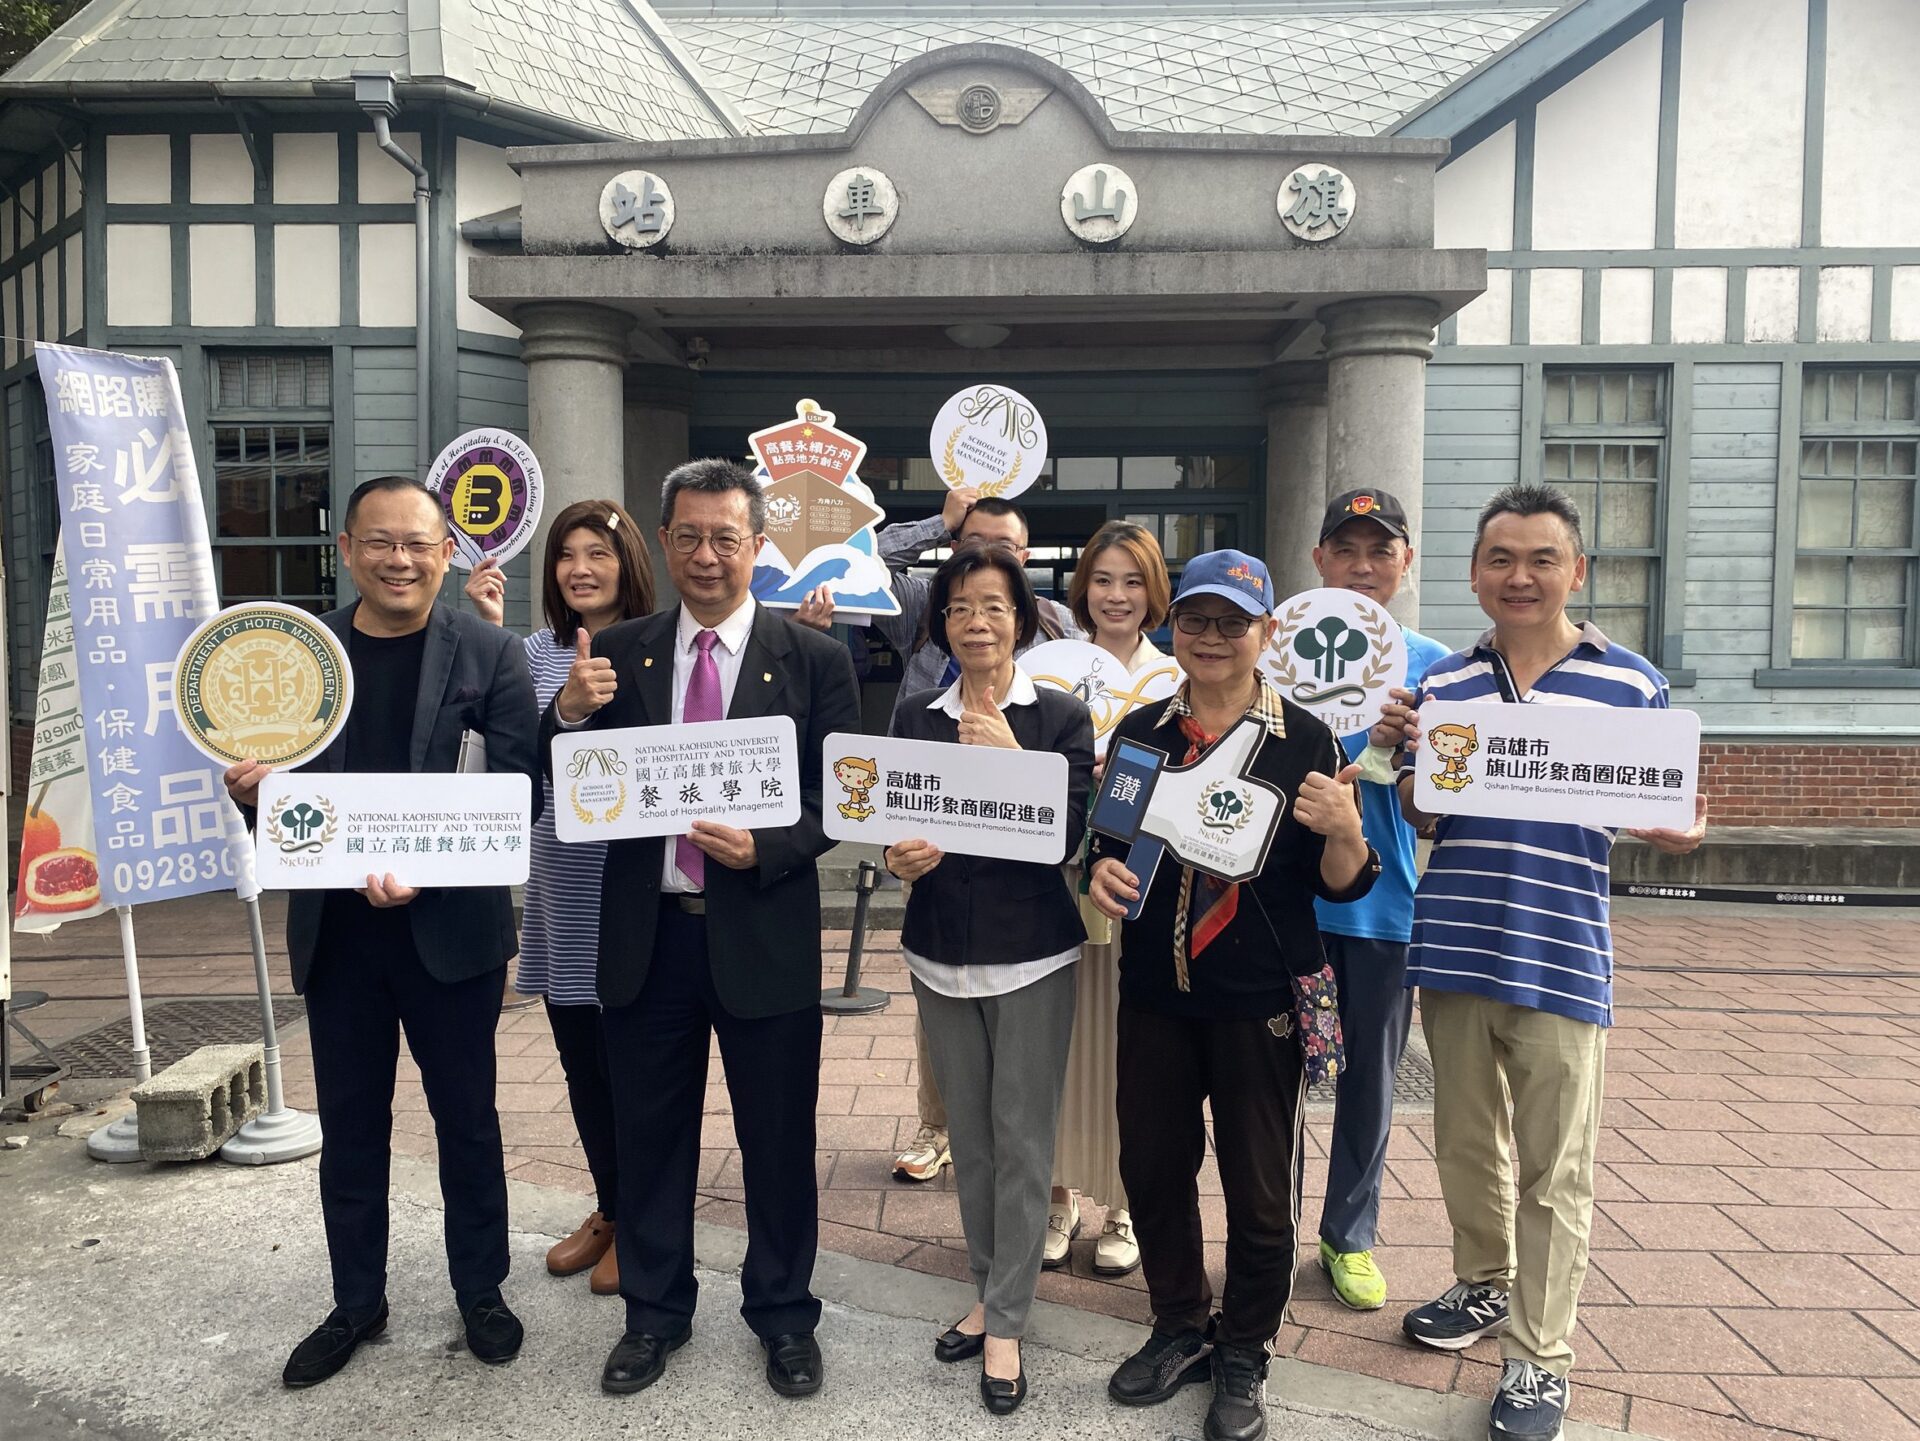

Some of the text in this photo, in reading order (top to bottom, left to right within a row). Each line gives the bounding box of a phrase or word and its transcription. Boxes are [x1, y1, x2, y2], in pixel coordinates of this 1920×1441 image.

[764, 440, 852, 462] 高餐永續方舟
[961, 441, 1007, 467] HOSPITALITY
[968, 435, 1009, 458] SCHOOL OF
[772, 454, 843, 471] 點亮地方創生
[956, 448, 1006, 476] MANAGEMENT
[441, 461, 449, 471] of
[449, 435, 492, 463] Hospitality
[493, 435, 501, 444] &
[525, 466, 538, 513] Marketing
[188, 618, 335, 714] DEPARTMENT OF HOTEL MANAGEMENT
[1316, 712, 1364, 730] UHT
[232, 737, 300, 758] NKUHT
[635, 736, 780, 754] NATIONAL KAOHSIUNG UNIVERSITY
[635, 746, 780, 764] OF HOSPITALITY AND TOURISM
[1488, 736, 1550, 757] 高雄市
[636, 757, 782, 782] 國立高雄餐旅大學
[1486, 758, 1684, 788] 旗山形象商圈促進會
[886, 770, 942, 792] 高雄市
[1110, 772, 1142, 806] 讚
[640, 777, 784, 809] 餐旅學院
[1484, 782, 1683, 802] Qishan Image Business District Promotion Association
[348, 812, 522, 822] NATIONAL KAOHSIUNG UNIVERSITY
[639, 801, 784, 818] School of Hospitality Management
[886, 790, 1056, 825] 旗山形象商圈促進會
[348, 823, 522, 832] OF HOSPITALITY AND TOURISM
[885, 812, 1055, 837] Qishan Image Business District Promotion Association
[346, 835, 522, 854] 國立高雄餐旅大學
[1198, 827, 1232, 845] NKUHT
[280, 856, 324, 867] NKUHT
